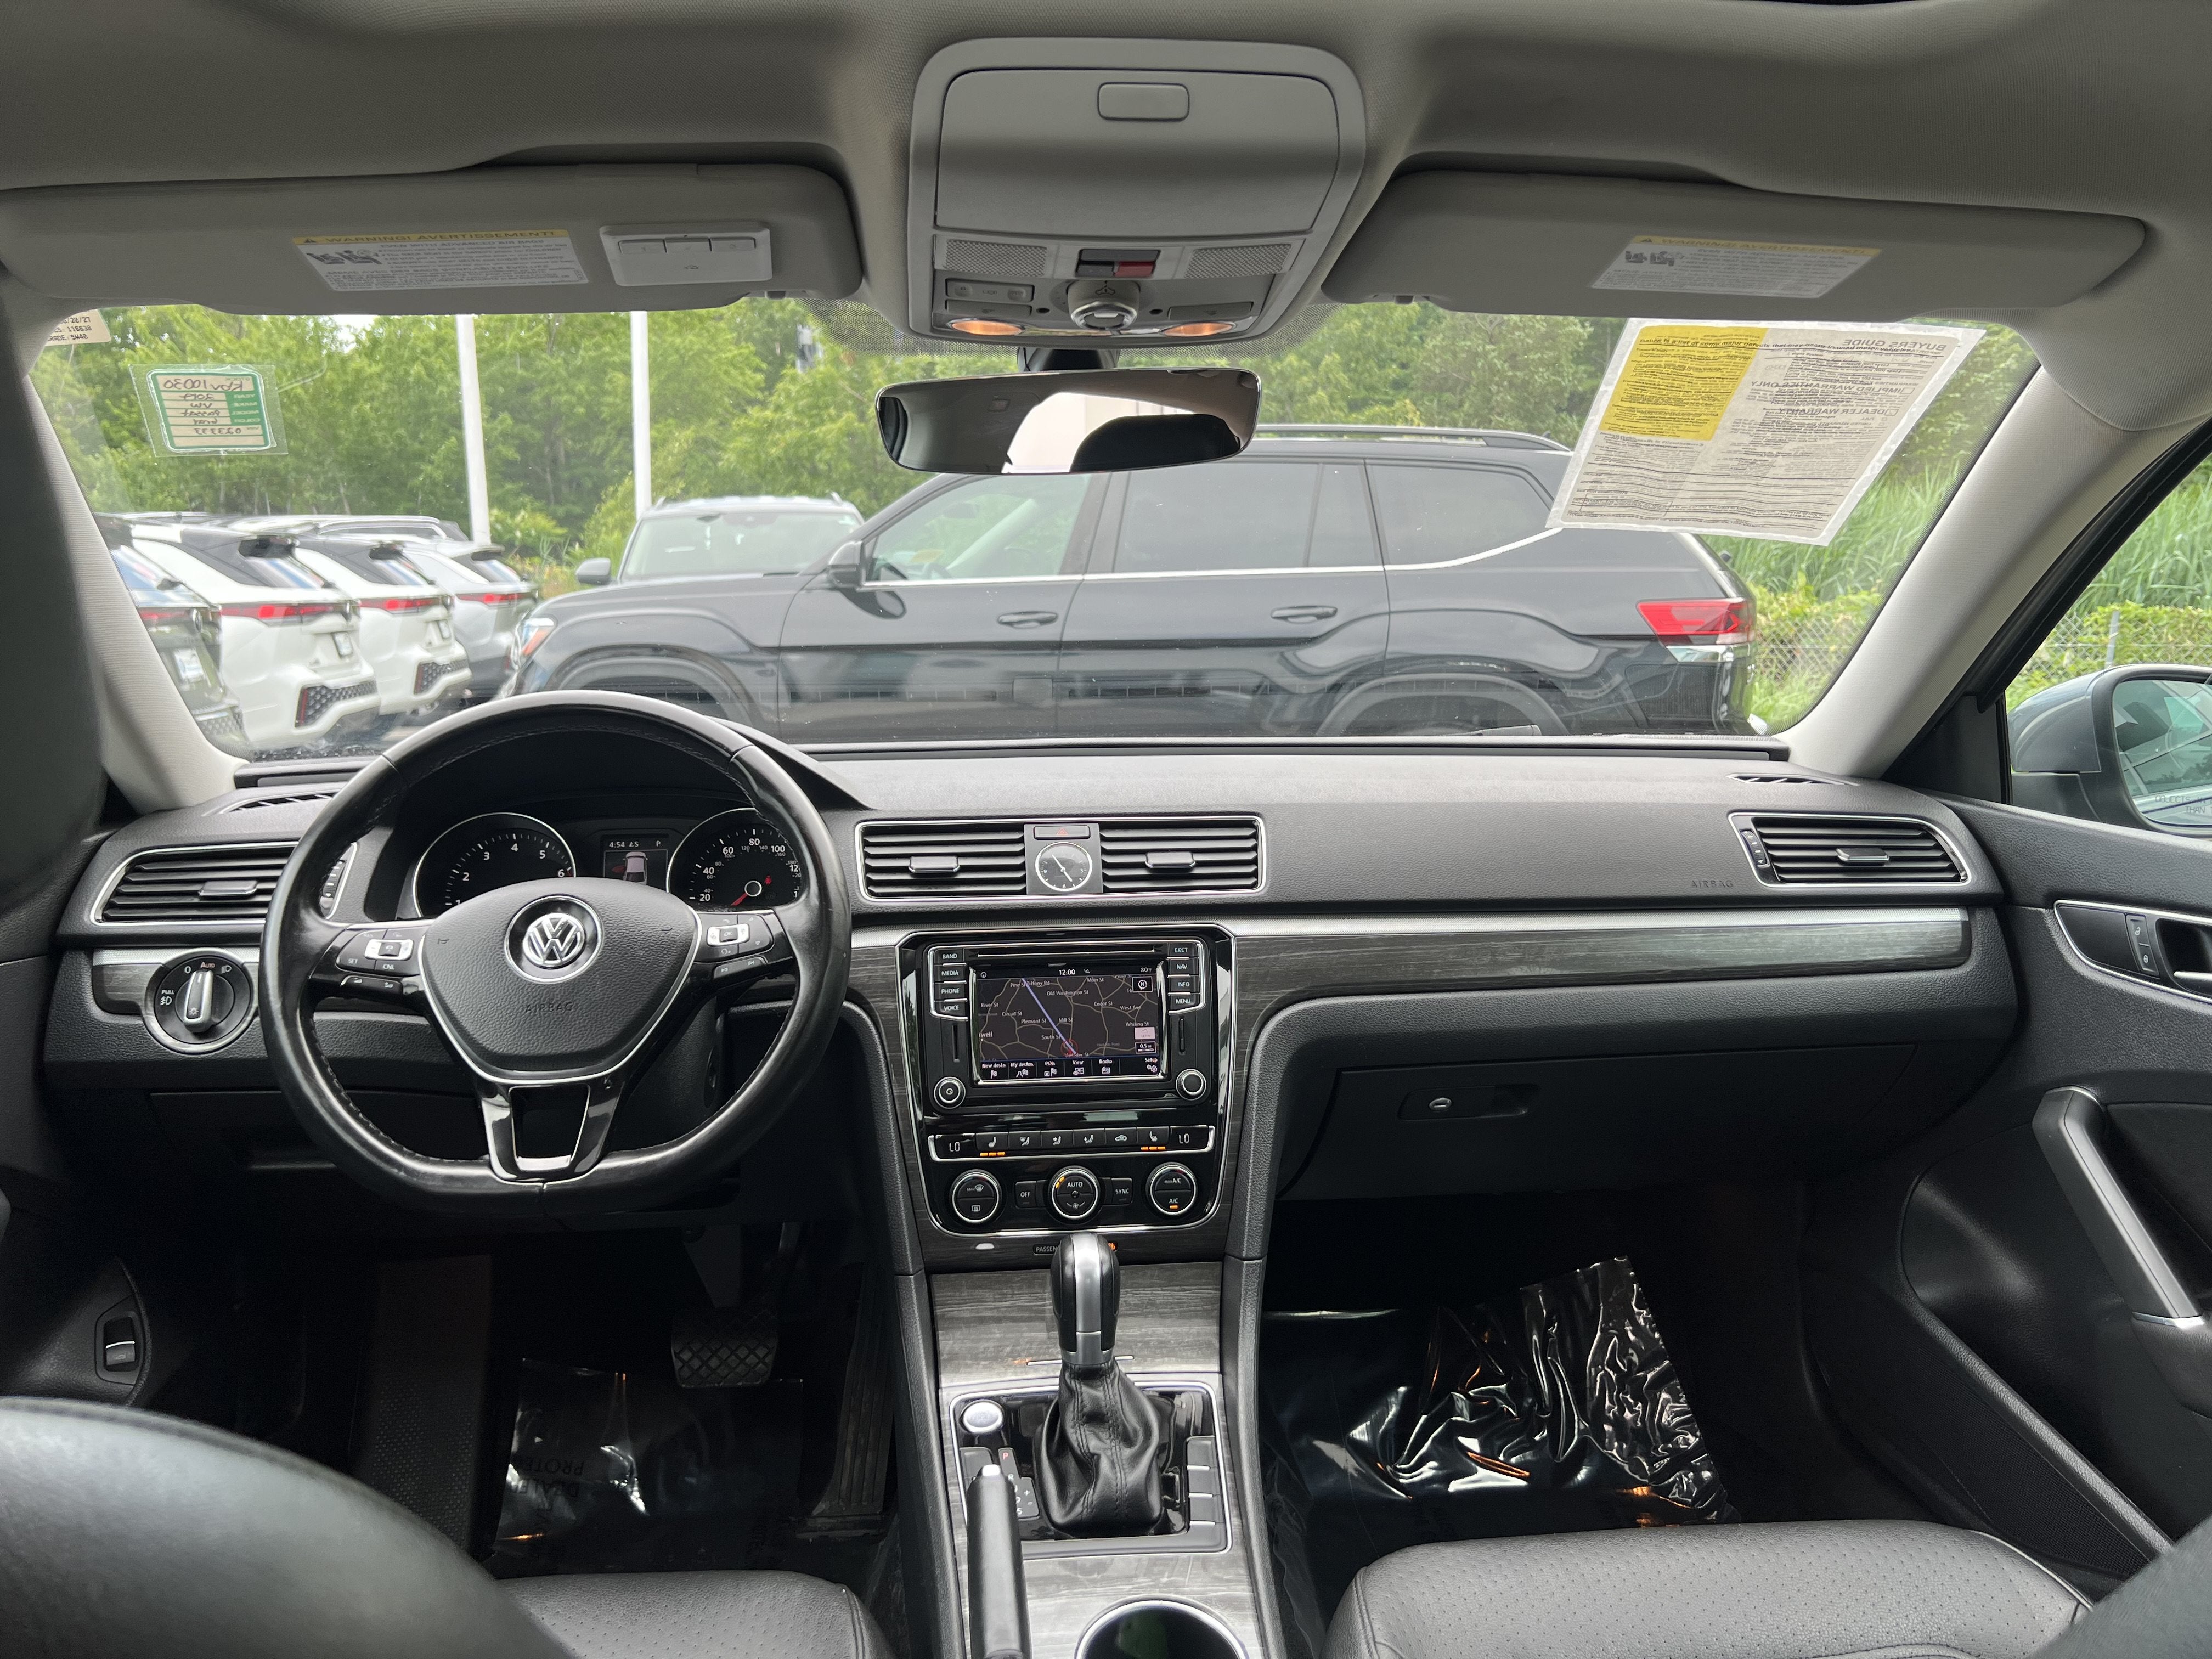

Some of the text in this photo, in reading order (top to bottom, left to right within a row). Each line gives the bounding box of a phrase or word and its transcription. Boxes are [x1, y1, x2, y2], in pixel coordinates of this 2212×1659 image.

[417, 231, 554, 240] AVERTISSEMENT!
[748, 838, 760, 846] 80
[511, 843, 518, 851] 4
[483, 851, 490, 861] 3
[539, 850, 546, 859] 5
[462, 872, 470, 881] 2
[557, 869, 565, 878] 6
[525, 1002, 573, 1013] AIRBAG
[1179, 1133, 1189, 1144] LO
[949, 1142, 960, 1152] LO
